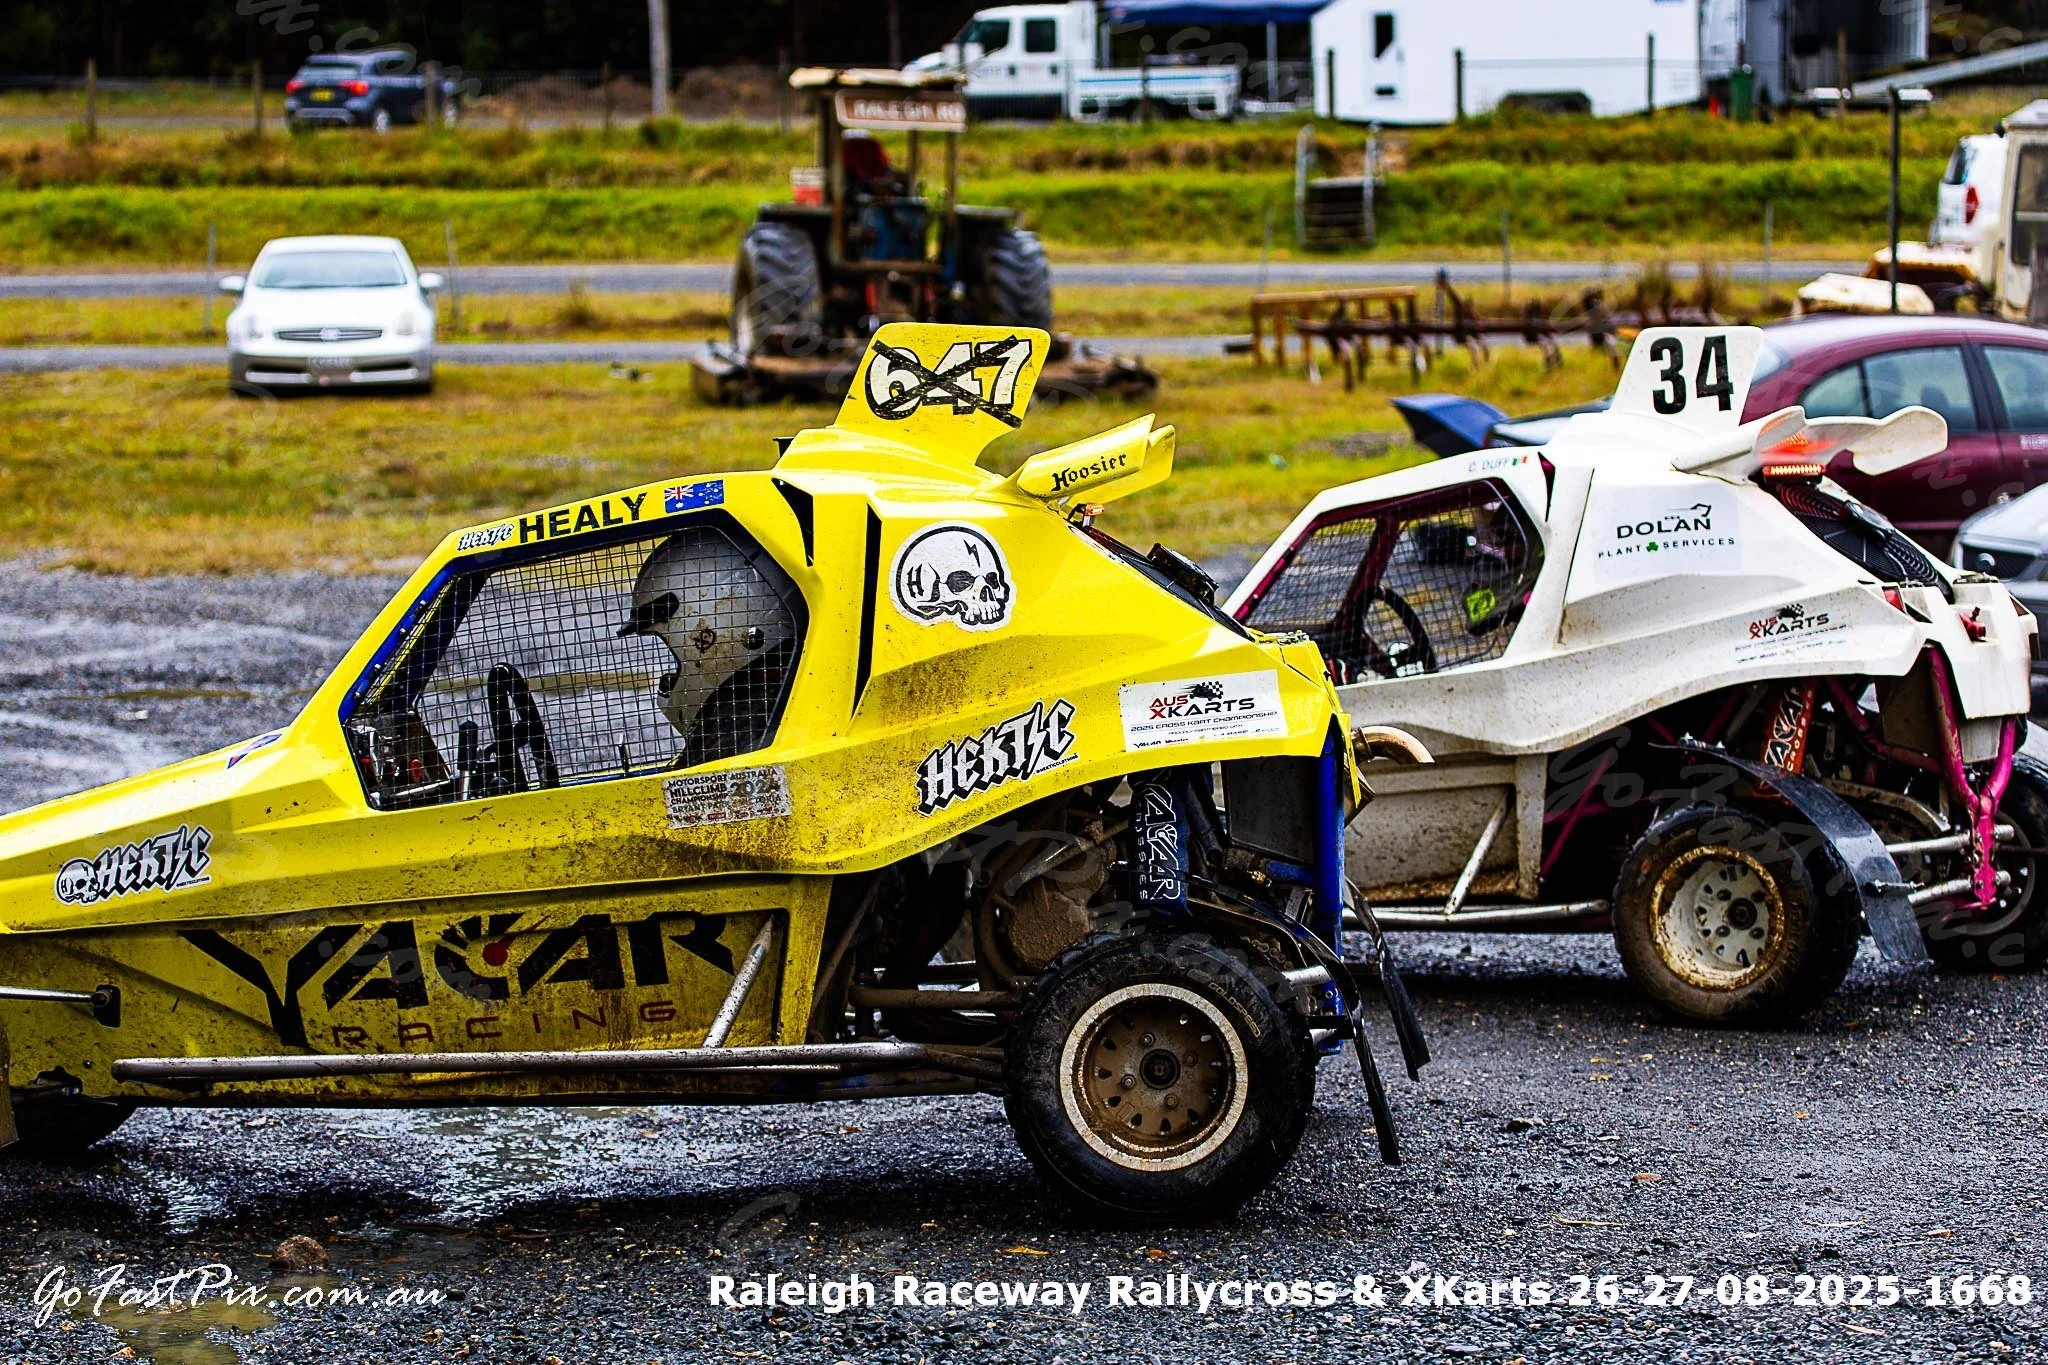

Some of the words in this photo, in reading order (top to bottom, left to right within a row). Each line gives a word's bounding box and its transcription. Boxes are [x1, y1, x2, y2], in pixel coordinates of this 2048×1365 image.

[865, 339, 1032, 420] 647
[1650, 335, 1734, 414] 34
[1051, 454, 1126, 491] Hoosier
[519, 492, 648, 544] HEALY
[1616, 518, 1711, 539] DOLAN
[1598, 544, 1641, 559] PLANT
[1663, 537, 1735, 549] SERVICES
[1749, 616, 1778, 631] AUS
[1750, 613, 1829, 639] XKARTS
[1150, 695, 1188, 708] AUS
[1150, 698, 1255, 720] XKARTS
[1131, 724, 1153, 732] 2025
[1155, 721, 1186, 729] CROSS
[1188, 718, 1212, 726] KART
[917, 699, 1075, 814] HEKTIC
[668, 774, 727, 788] MOTORSPORT
[730, 768, 777, 780] AUSTRALIA
[670, 783, 727, 798] HILLCLIMB
[671, 793, 728, 805] CHAMPIONSHIP
[95, 825, 211, 899] HEKTIC
[175, 911, 736, 1048] YACAR
[1208, 982, 1261, 1037] GOLDSPEED
[334, 1000, 677, 1049] RACING
